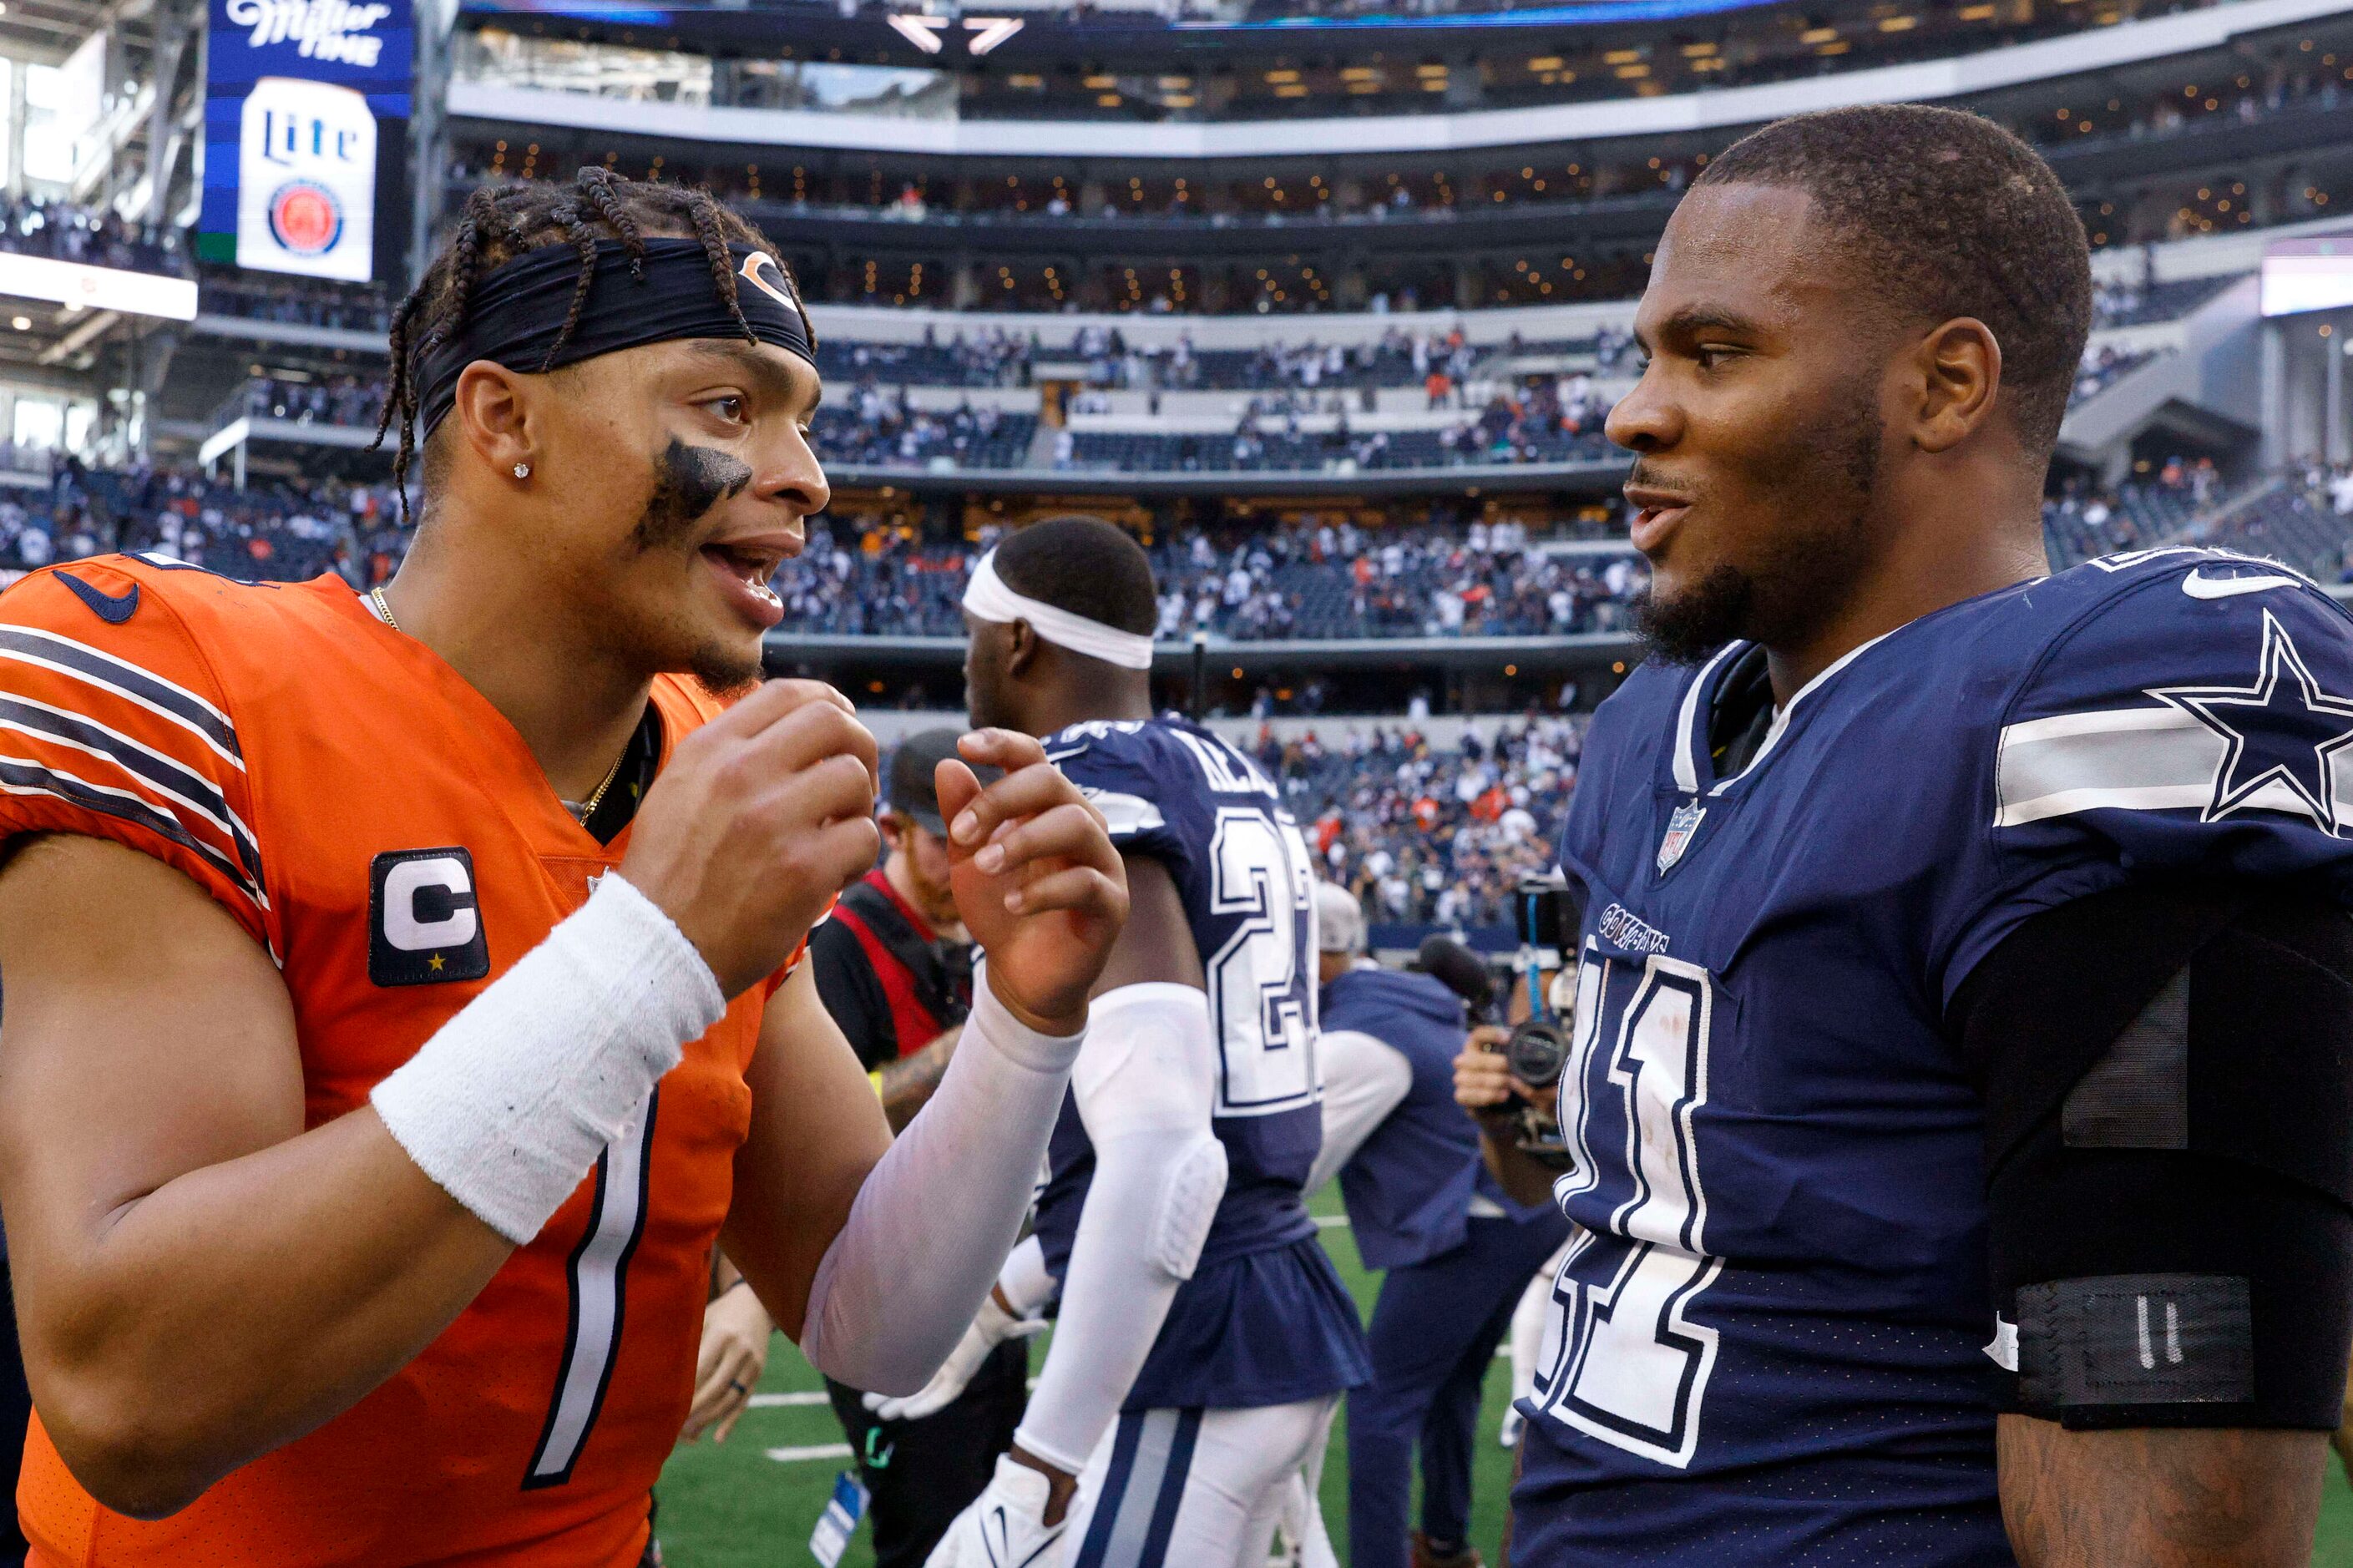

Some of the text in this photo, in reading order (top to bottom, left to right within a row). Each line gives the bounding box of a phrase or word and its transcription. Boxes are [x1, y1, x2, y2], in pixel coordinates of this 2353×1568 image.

[225, 0, 391, 48] Miller
[298, 33, 384, 68] TIME
[264, 109, 357, 166] Lite
[383, 857, 478, 951] C
[2137, 1294, 2184, 1370] 11
